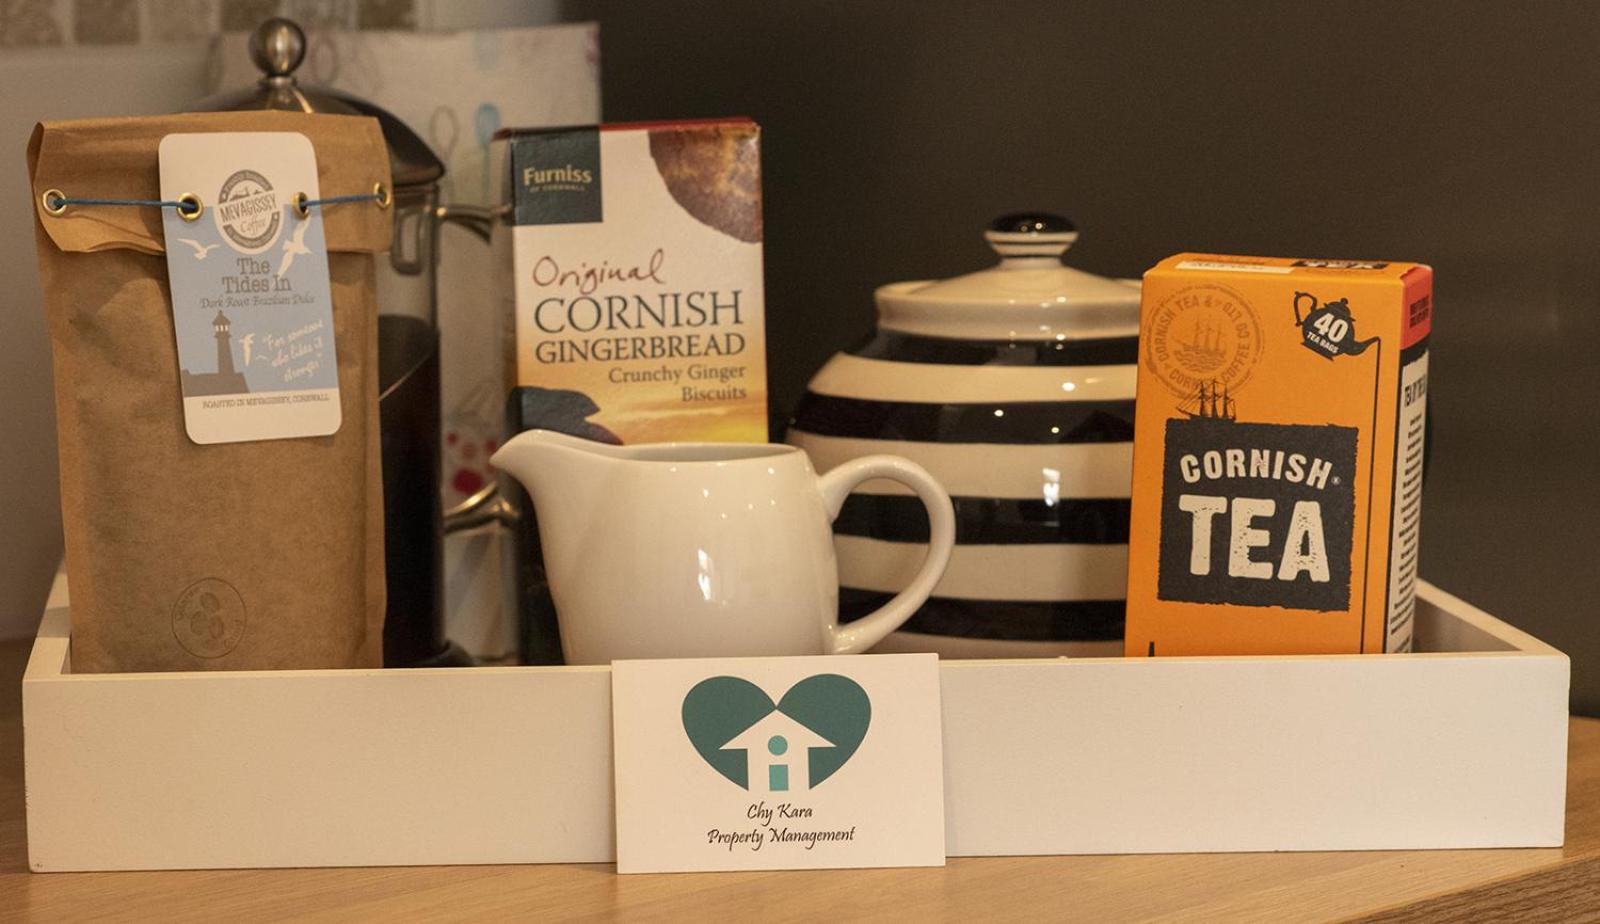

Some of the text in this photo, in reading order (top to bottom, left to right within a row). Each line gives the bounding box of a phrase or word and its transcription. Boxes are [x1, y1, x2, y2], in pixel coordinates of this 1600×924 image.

[523, 164, 593, 186] Furniss
[220, 193, 277, 222] MEVAGISSEY
[237, 257, 271, 275] The
[533, 248, 667, 295] Original
[221, 275, 292, 294] Tides In
[534, 290, 744, 334] CORNISH
[1175, 294, 1200, 311] TEA
[1314, 312, 1348, 343] 40
[535, 333, 745, 364] GINGERBREAD
[1306, 331, 1339, 354] TEA BAGS
[608, 365, 747, 384] Crunchy Ginger
[682, 387, 747, 402] Biscuits
[1178, 494, 1331, 583] TEA
[747, 801, 813, 827] Chy Kara
[707, 826, 856, 852] Property Management
